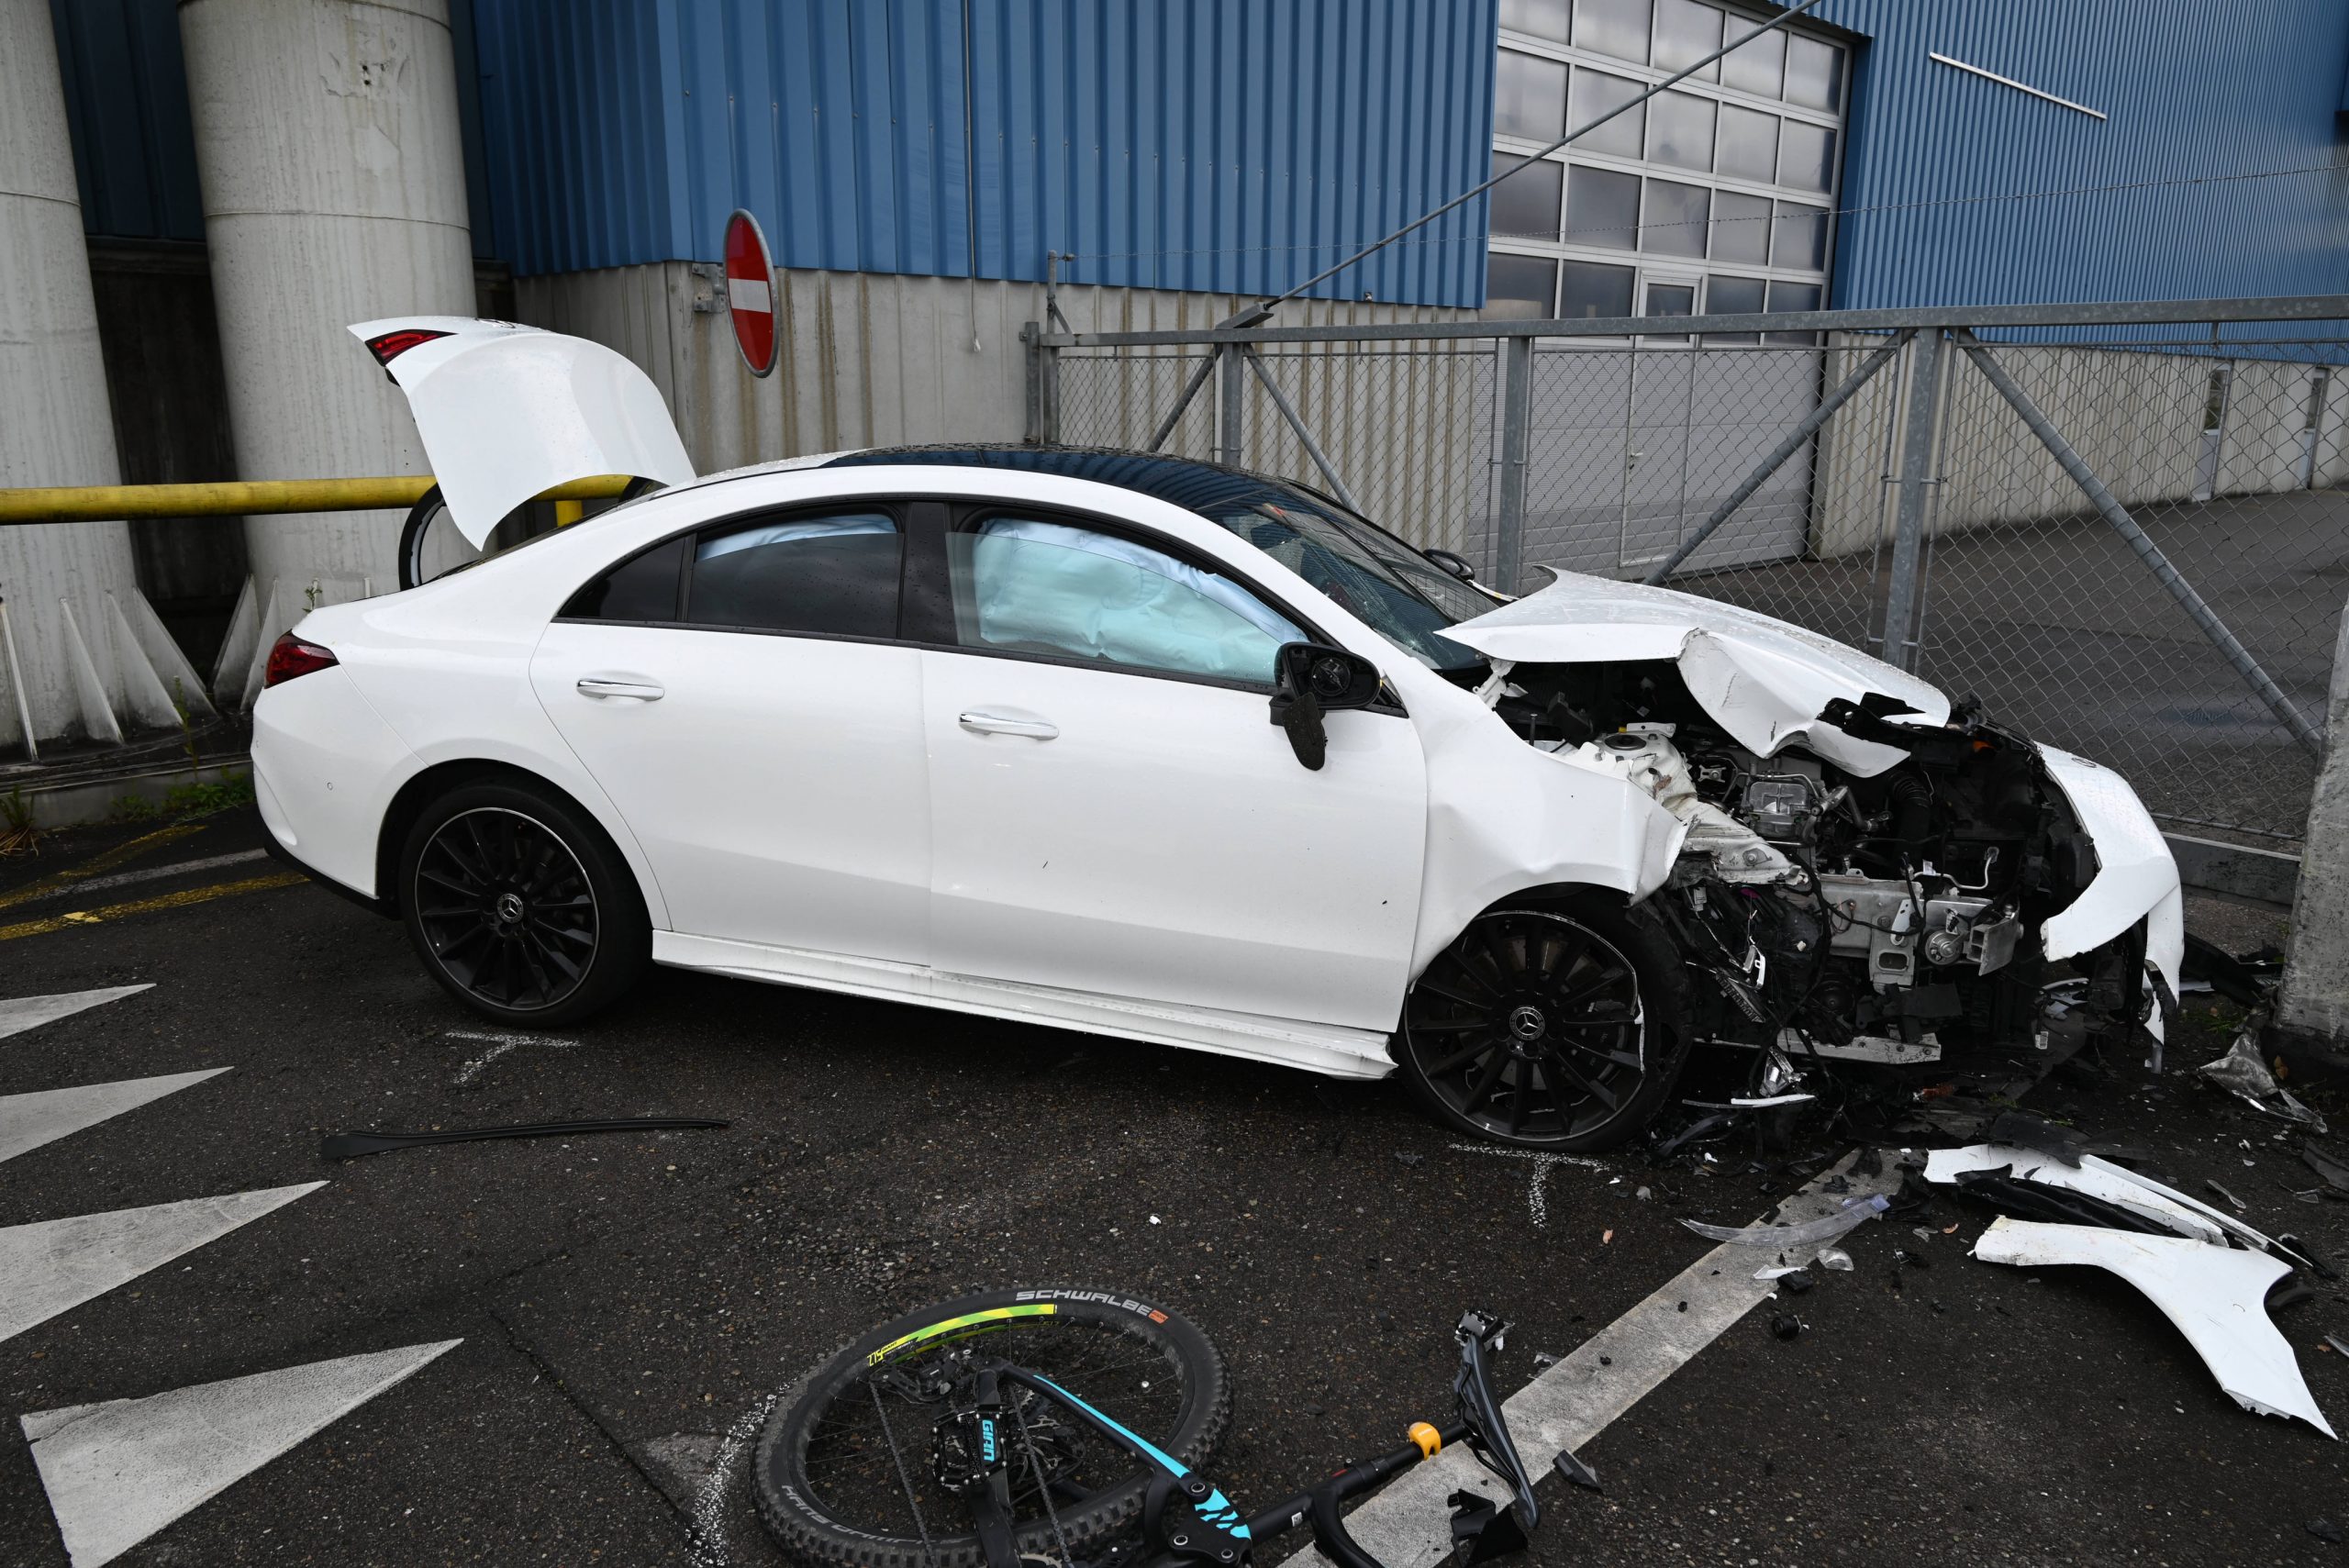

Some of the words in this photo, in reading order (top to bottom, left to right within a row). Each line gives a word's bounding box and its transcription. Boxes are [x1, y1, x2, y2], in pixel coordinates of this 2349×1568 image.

[1016, 1289, 1152, 1317] SCHWALBE
[982, 1419, 995, 1462] GIAN
[782, 1485, 832, 1524] HANS
